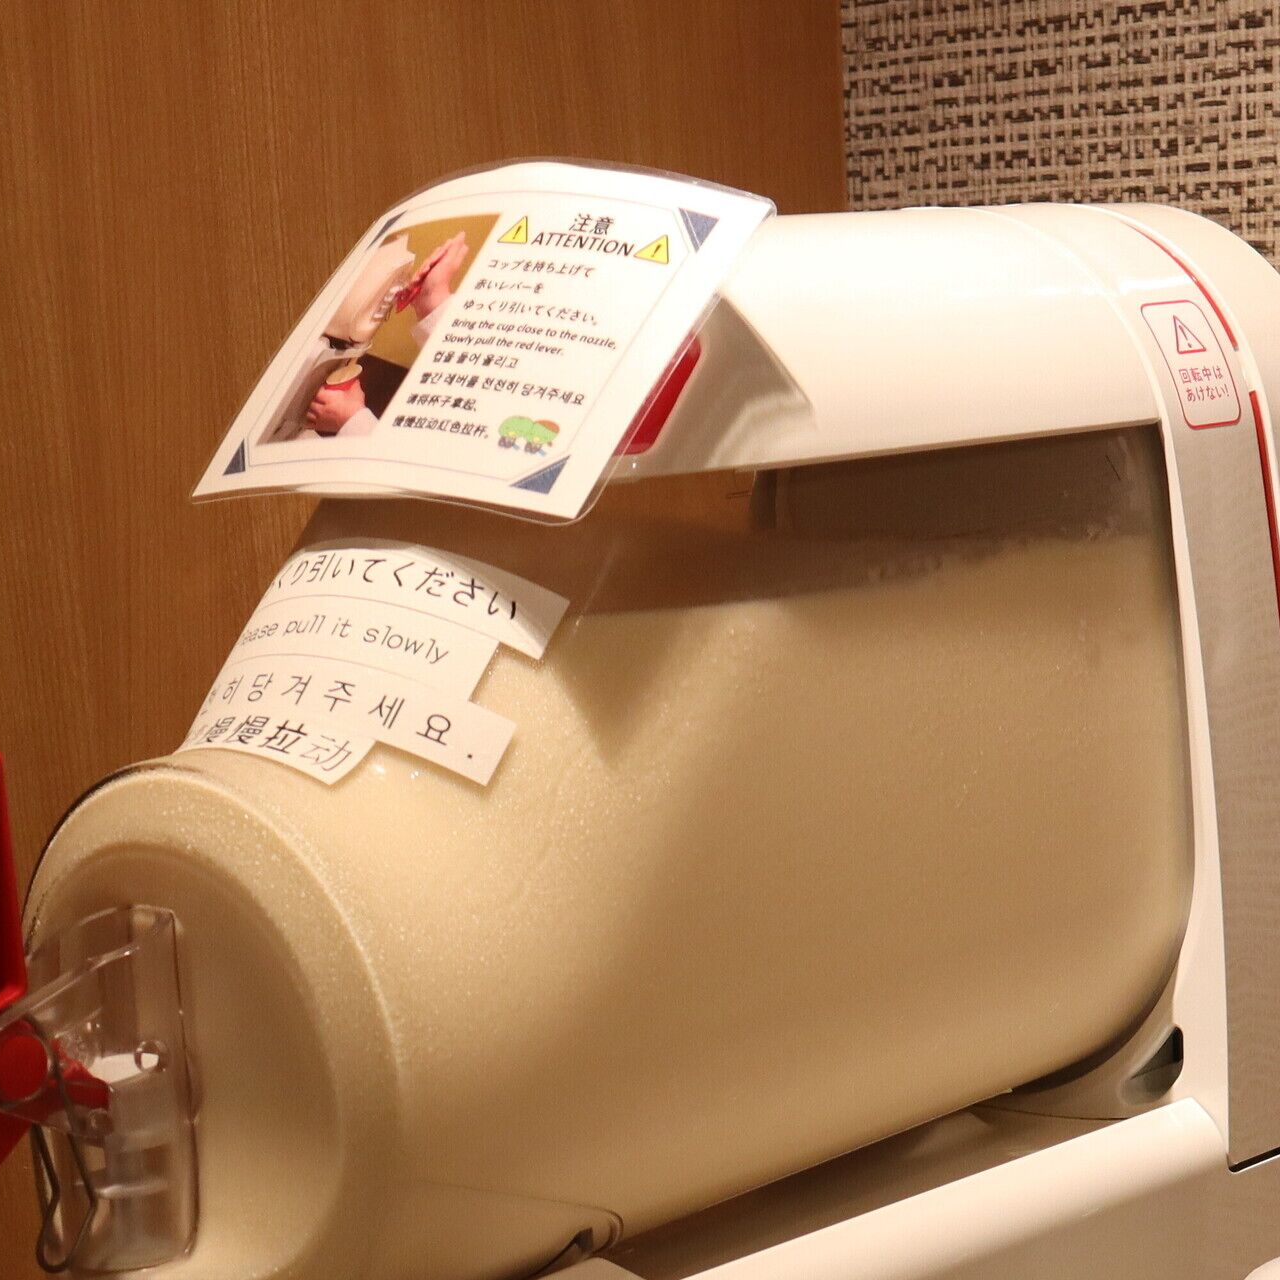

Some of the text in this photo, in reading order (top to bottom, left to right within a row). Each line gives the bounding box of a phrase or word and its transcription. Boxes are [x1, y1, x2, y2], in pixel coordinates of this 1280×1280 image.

[568, 213, 615, 236] 注意
[531, 231, 636, 257] ATTENTION
[487, 258, 597, 278] コップを持ち上げて
[474, 278, 545, 294] 赤いレバーを
[463, 299, 598, 326] ゆっくり引いてください。
[451, 317, 477, 331] Bring
[478, 319, 495, 330] the
[496, 323, 515, 333] cup
[516, 324, 543, 336] close
[545, 328, 557, 338] to
[559, 329, 578, 342] the
[442, 333, 564, 356] Slowly pull the red lever.
[1178, 364, 1224, 384] 回転中は
[268, 553, 518, 620] くり引いてください
[283, 613, 328, 637] pull
[331, 617, 353, 639] it
[363, 624, 450, 664] slowly
[190, 714, 355, 773] 慢慢拉动
